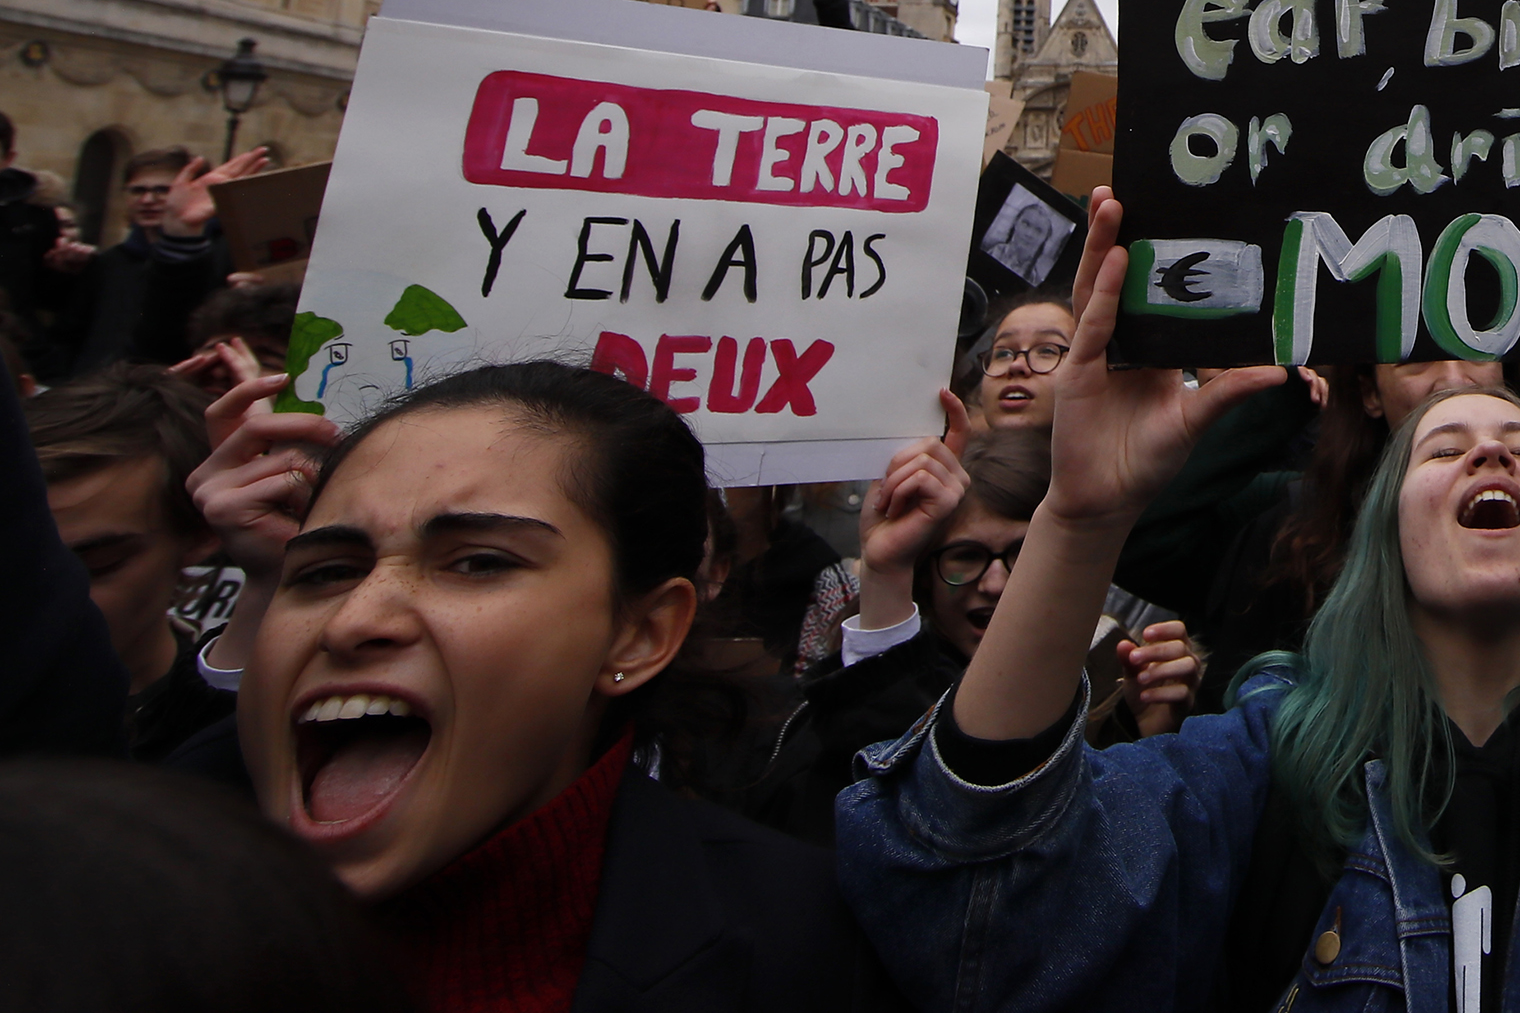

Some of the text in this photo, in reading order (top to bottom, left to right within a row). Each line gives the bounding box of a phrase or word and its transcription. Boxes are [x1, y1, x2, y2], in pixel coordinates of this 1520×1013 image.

[500, 96, 921, 202] LA TERRE
[1168, 111, 1293, 187] or
[475, 206, 887, 304] Y EN A PAS
[590, 330, 836, 417] DEUX
